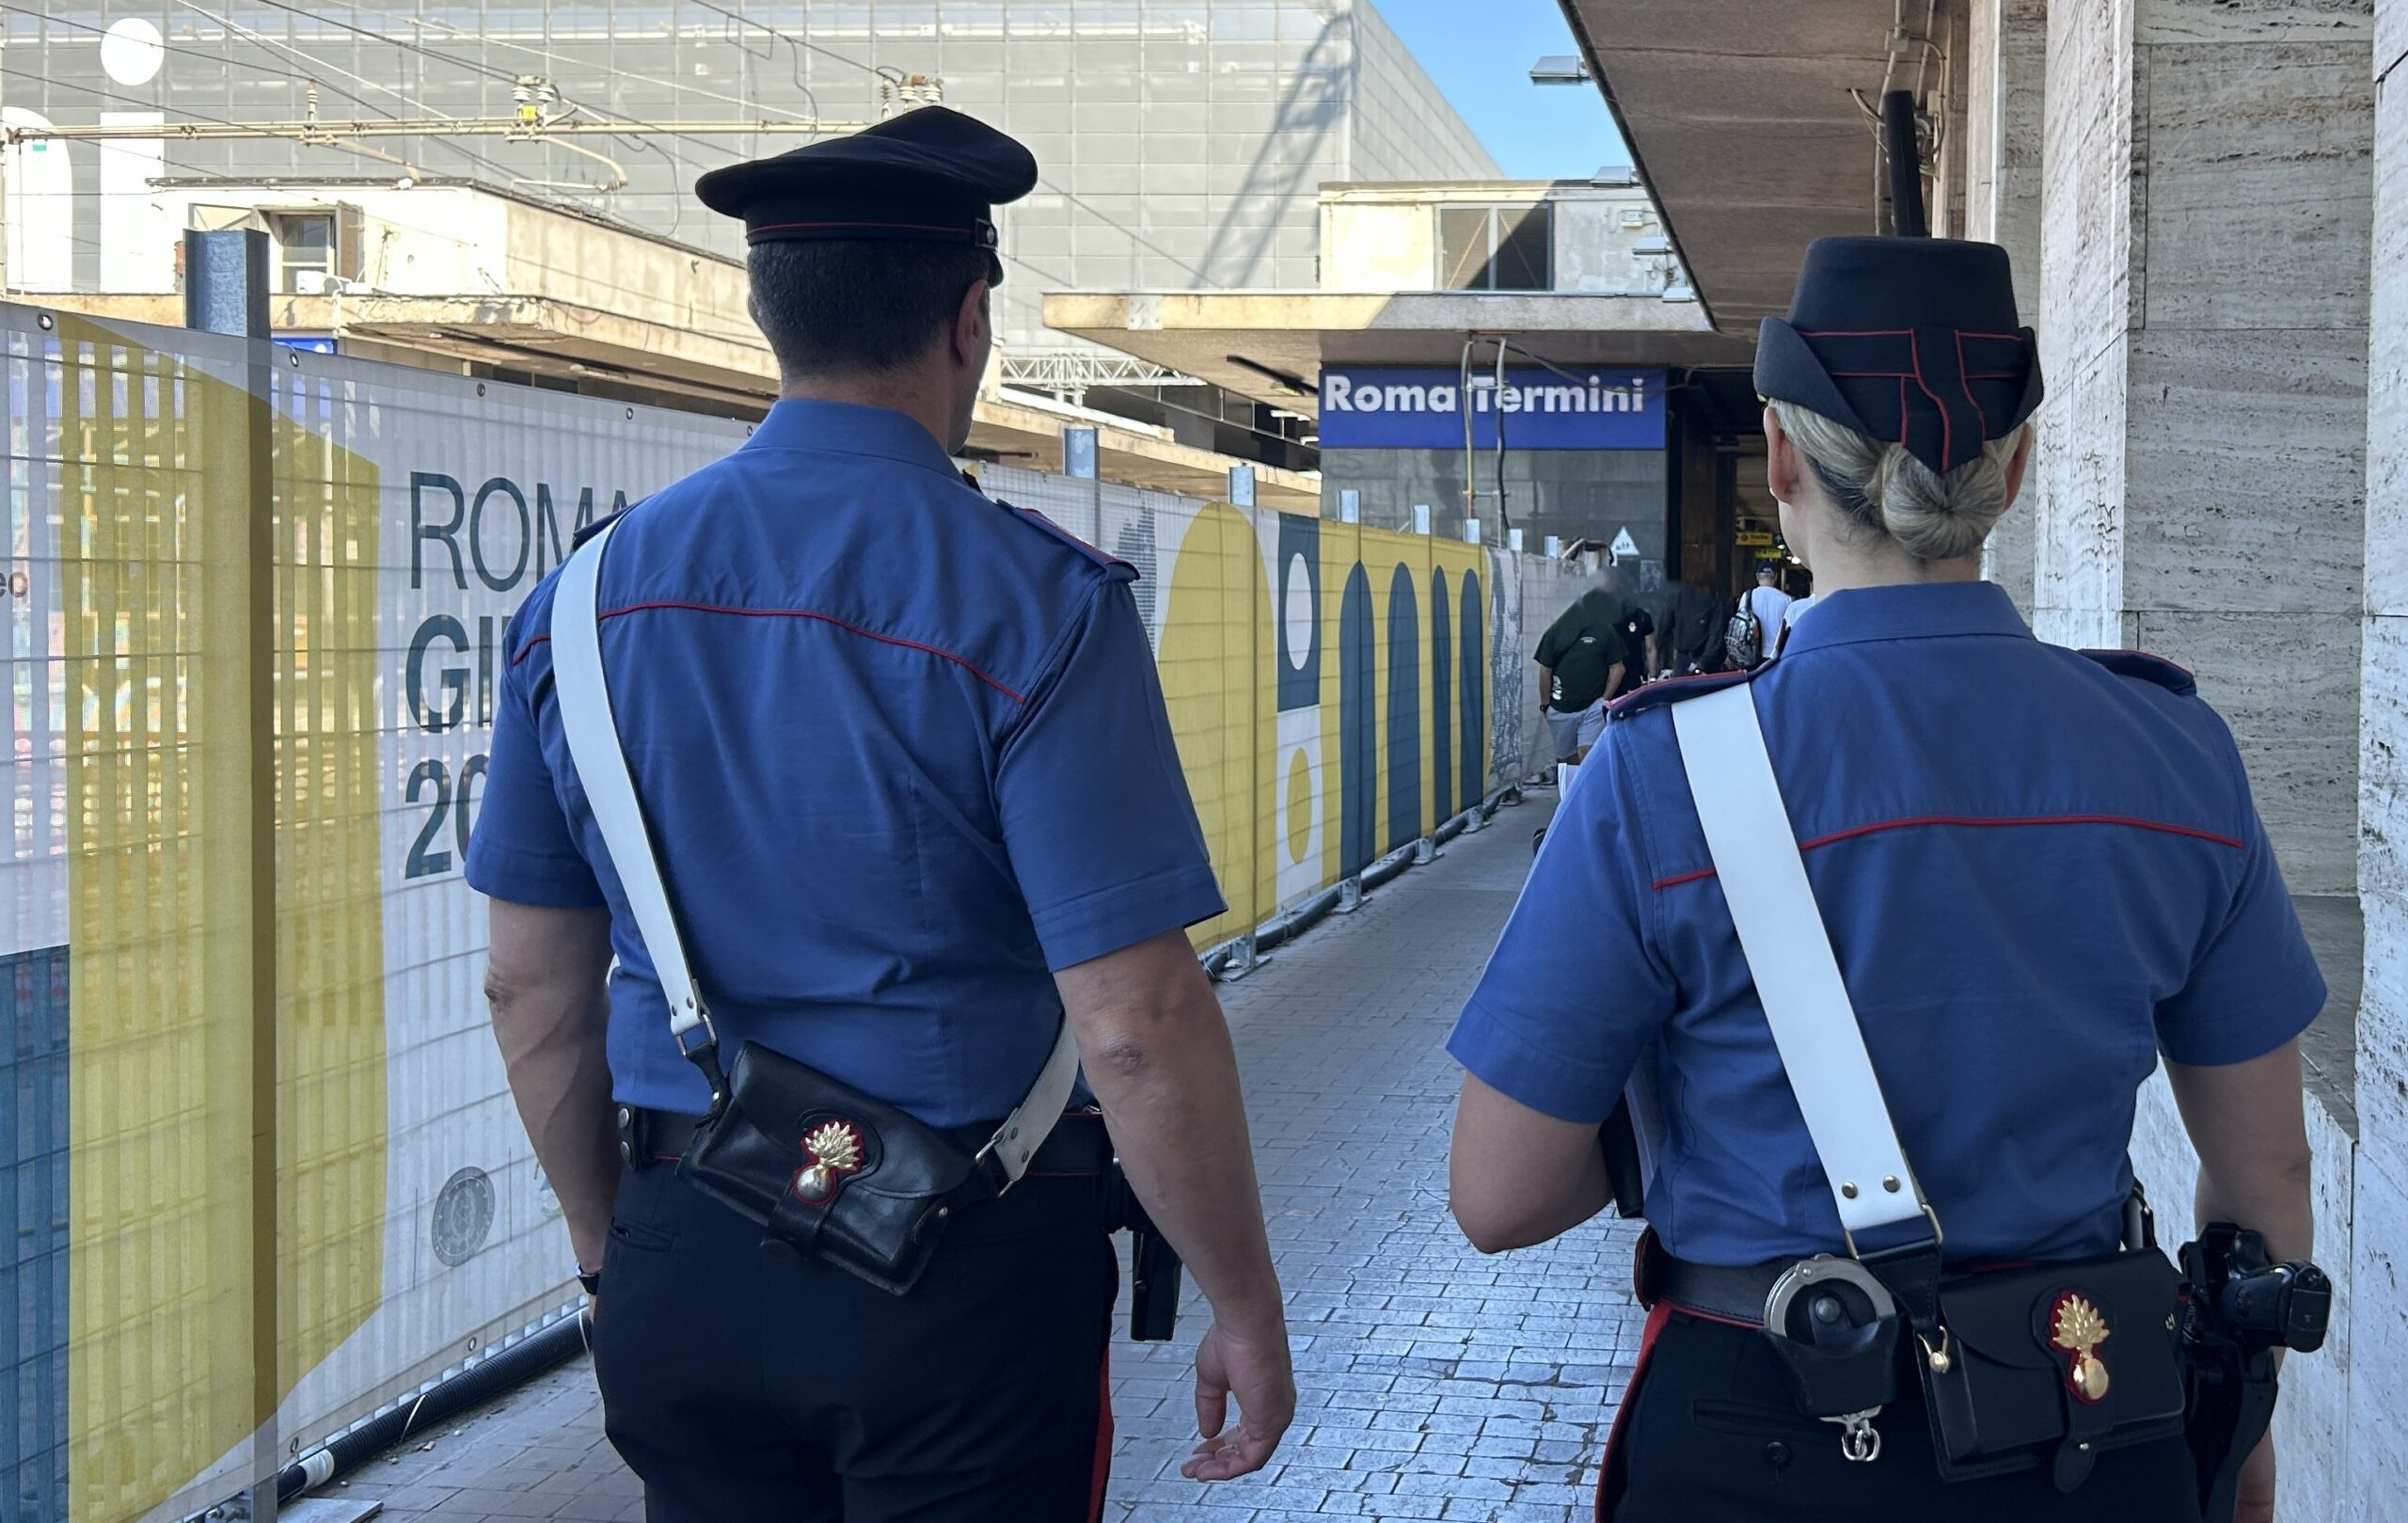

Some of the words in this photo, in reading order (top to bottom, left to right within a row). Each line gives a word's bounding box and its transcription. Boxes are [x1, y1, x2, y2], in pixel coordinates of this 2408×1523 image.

[1324, 374, 1456, 412] Roma
[1470, 374, 1643, 412] Termini
[409, 471, 628, 593] ROM
[404, 613, 513, 734] GI
